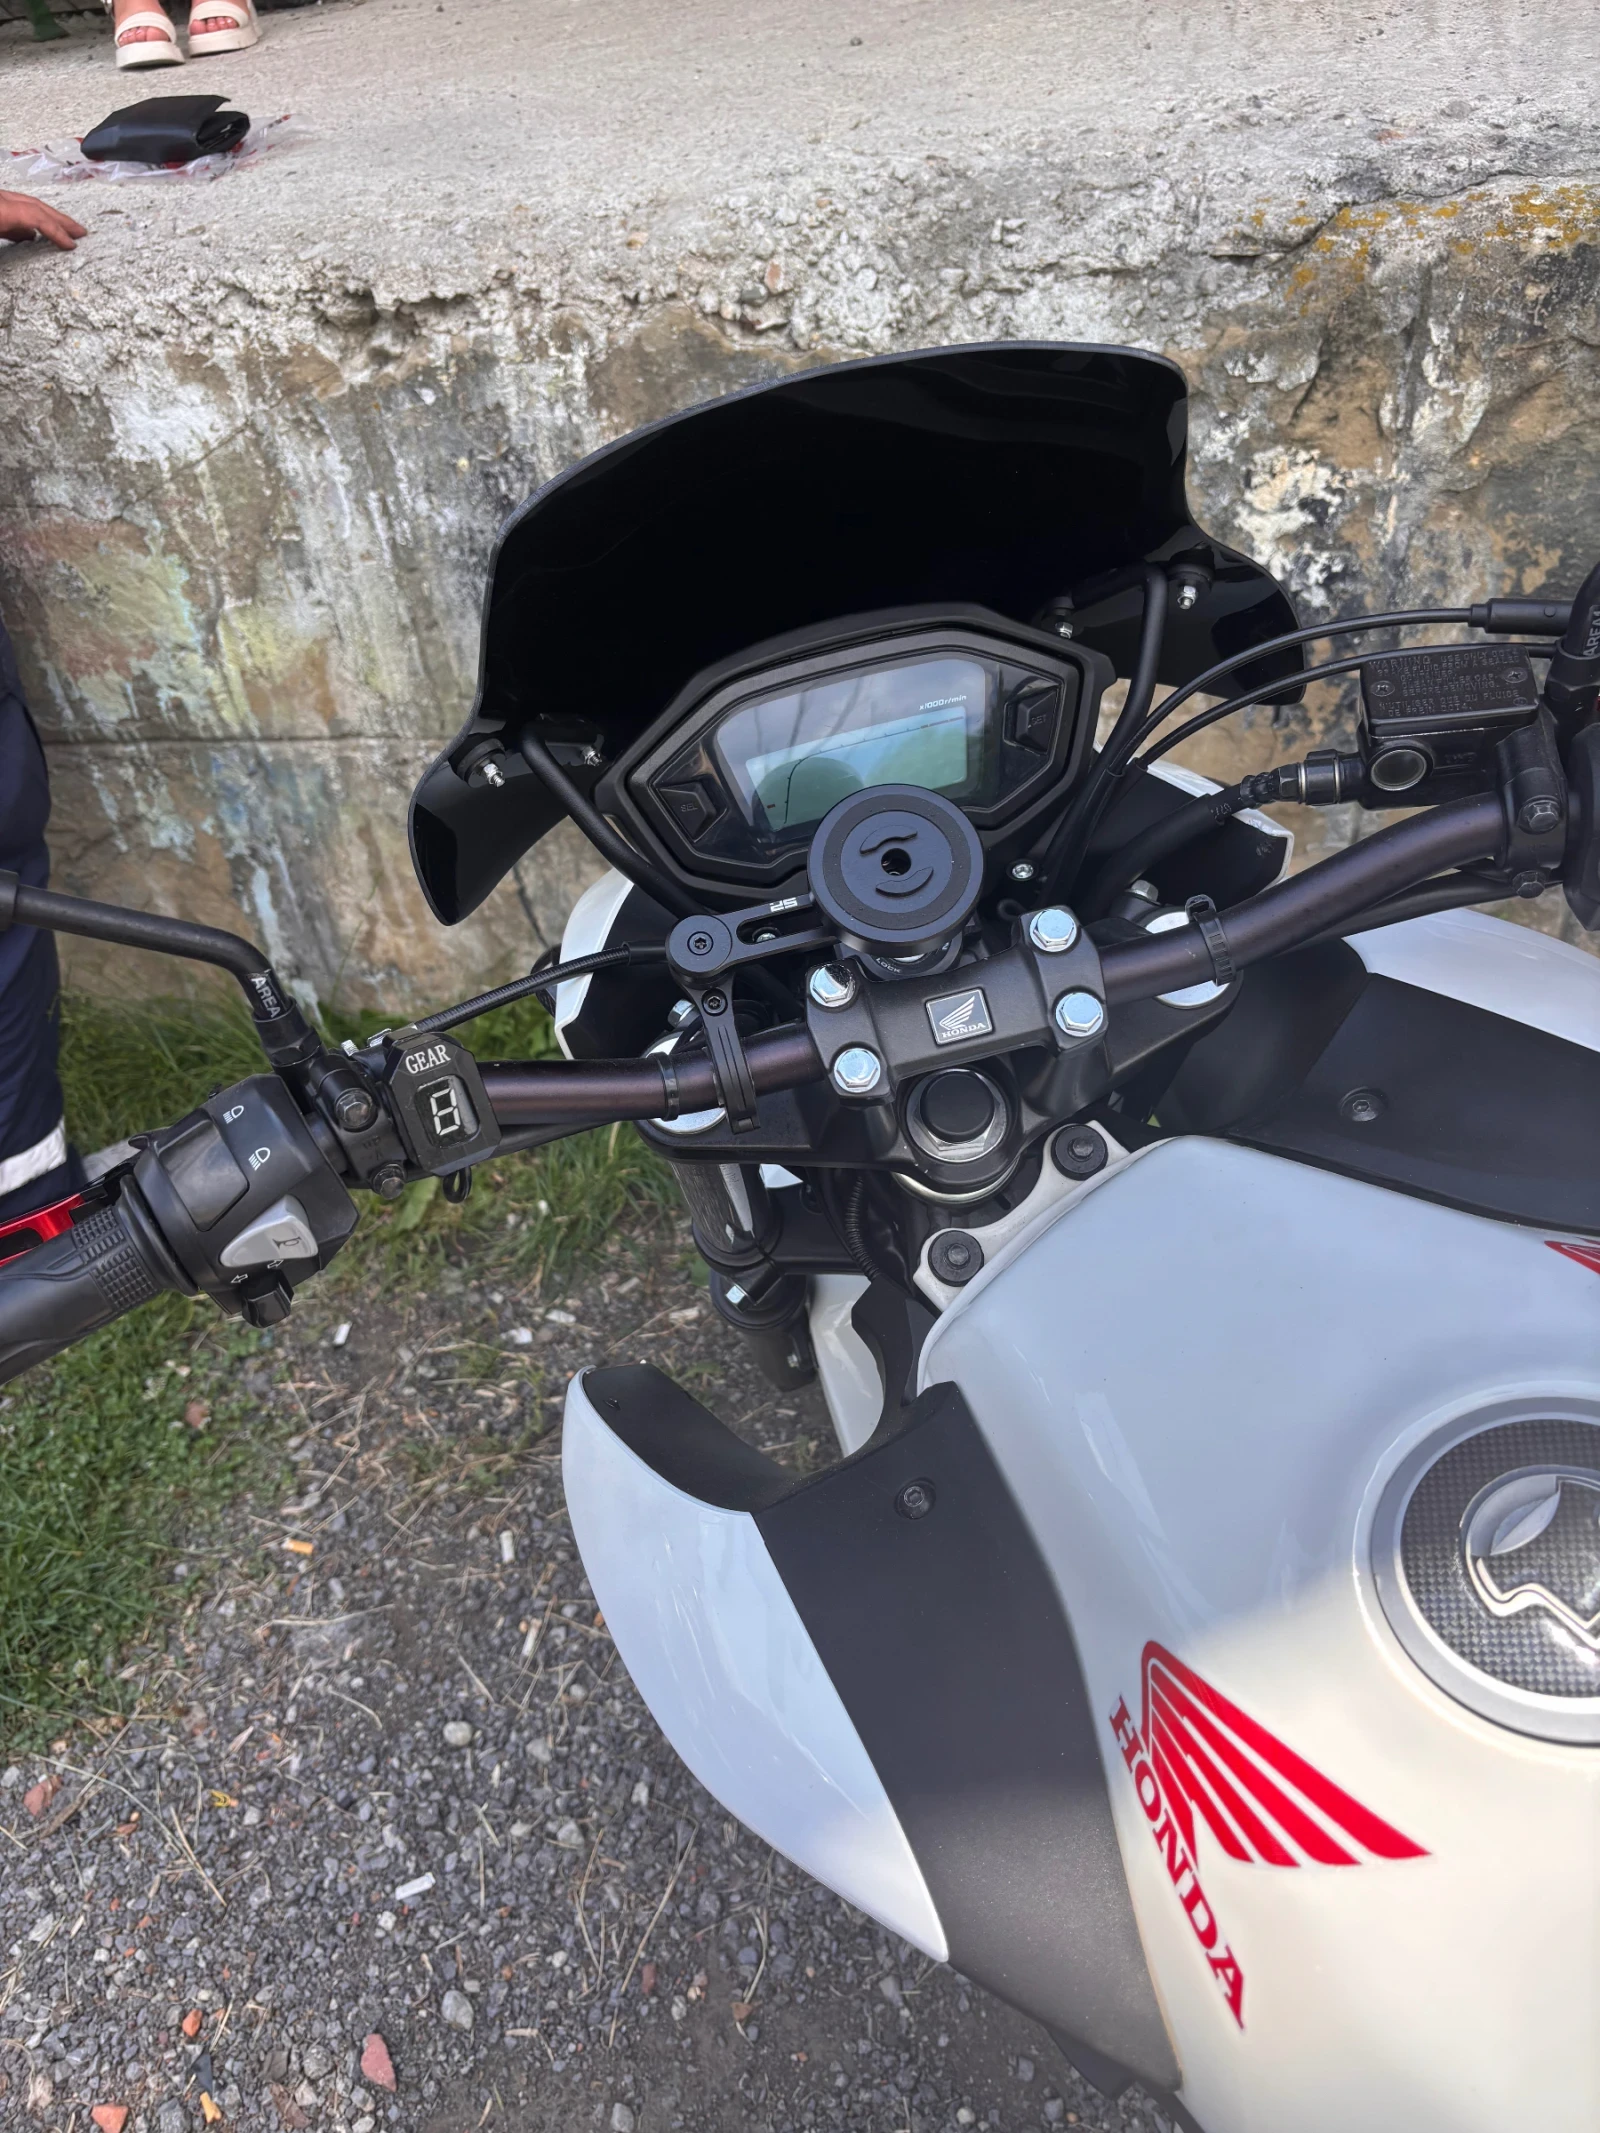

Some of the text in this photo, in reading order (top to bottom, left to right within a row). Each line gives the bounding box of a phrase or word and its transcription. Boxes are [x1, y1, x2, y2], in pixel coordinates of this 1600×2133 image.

[680, 801, 699, 813] SEL
[875, 957, 903, 974] LOCK
[250, 976, 281, 1018] AREA
[941, 1022, 986, 1038] HONDA
[405, 1044, 451, 1074] GEAR
[1109, 1694, 1244, 2031] HONDA
